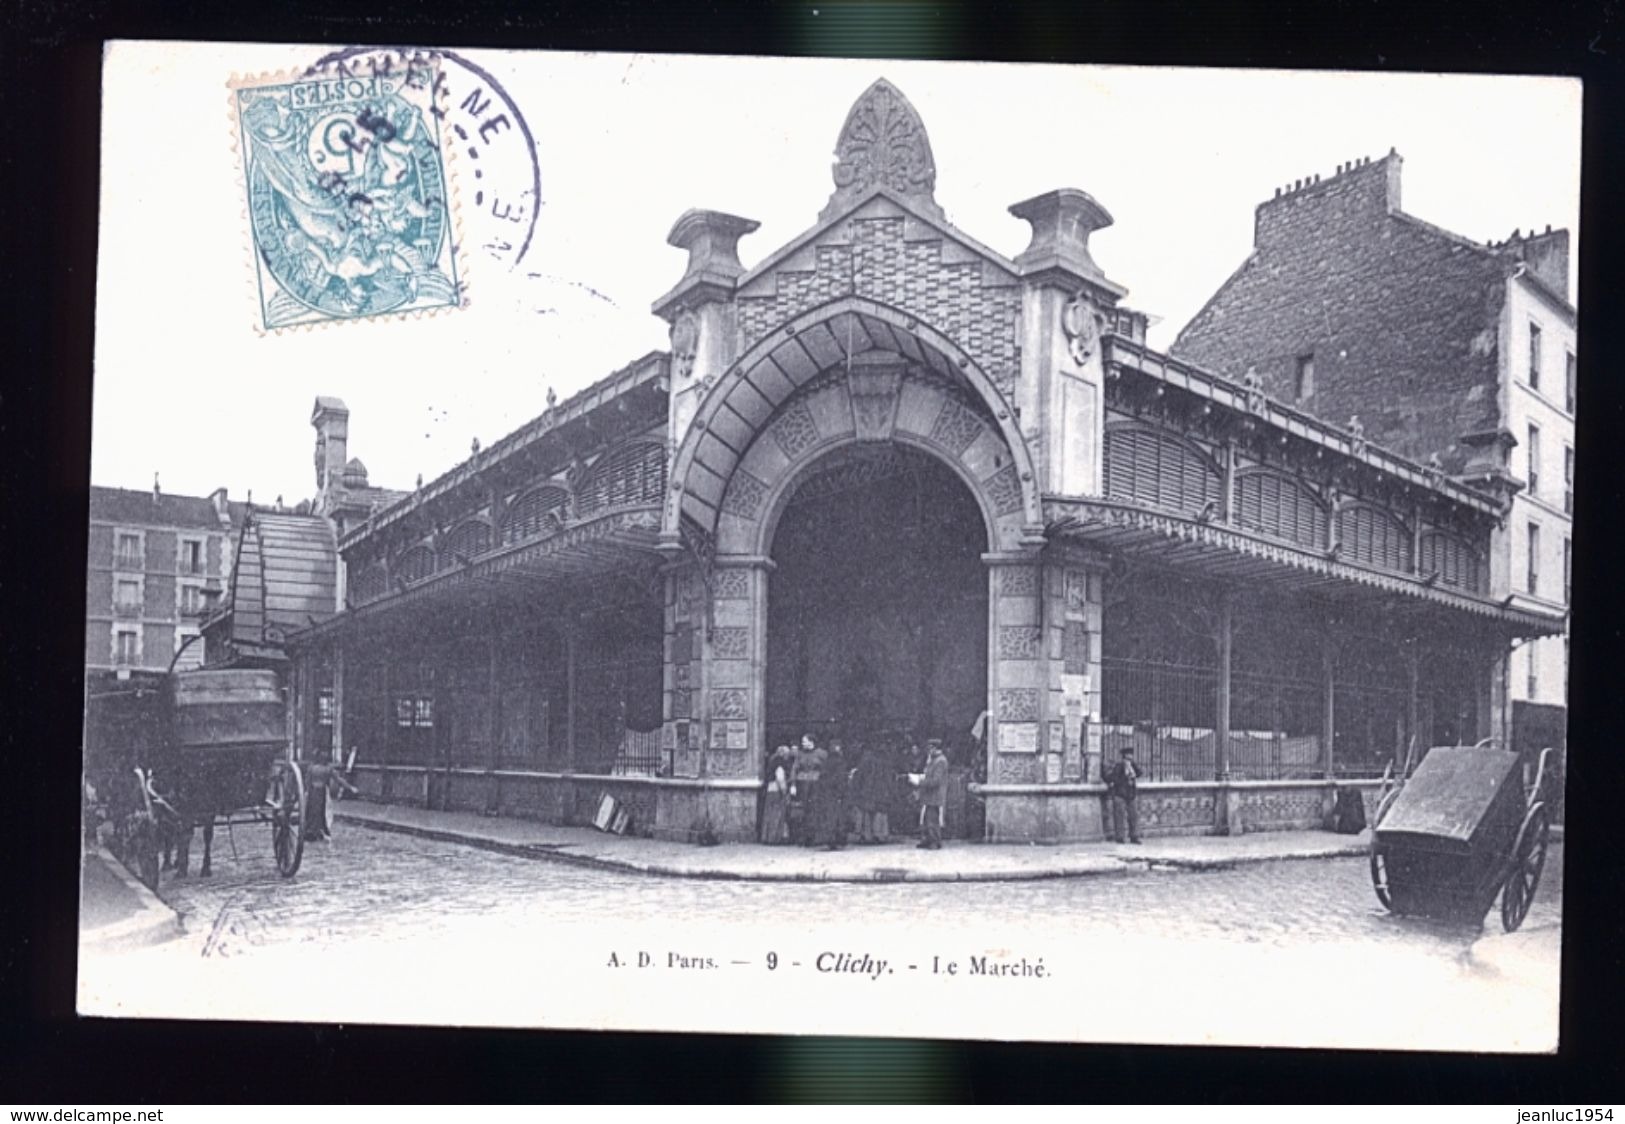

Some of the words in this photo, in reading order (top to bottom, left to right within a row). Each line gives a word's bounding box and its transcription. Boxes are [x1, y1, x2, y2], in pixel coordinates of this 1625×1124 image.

[293, 79, 379, 107] POSTES
[607, 951, 626, 967] A.
[638, 951, 656, 968] D.
[667, 951, 719, 970] Paris.
[766, 951, 778, 971] 9
[815, 951, 894, 981] Clichy.
[932, 955, 958, 976] Le
[969, 955, 1051, 978] Marché.
